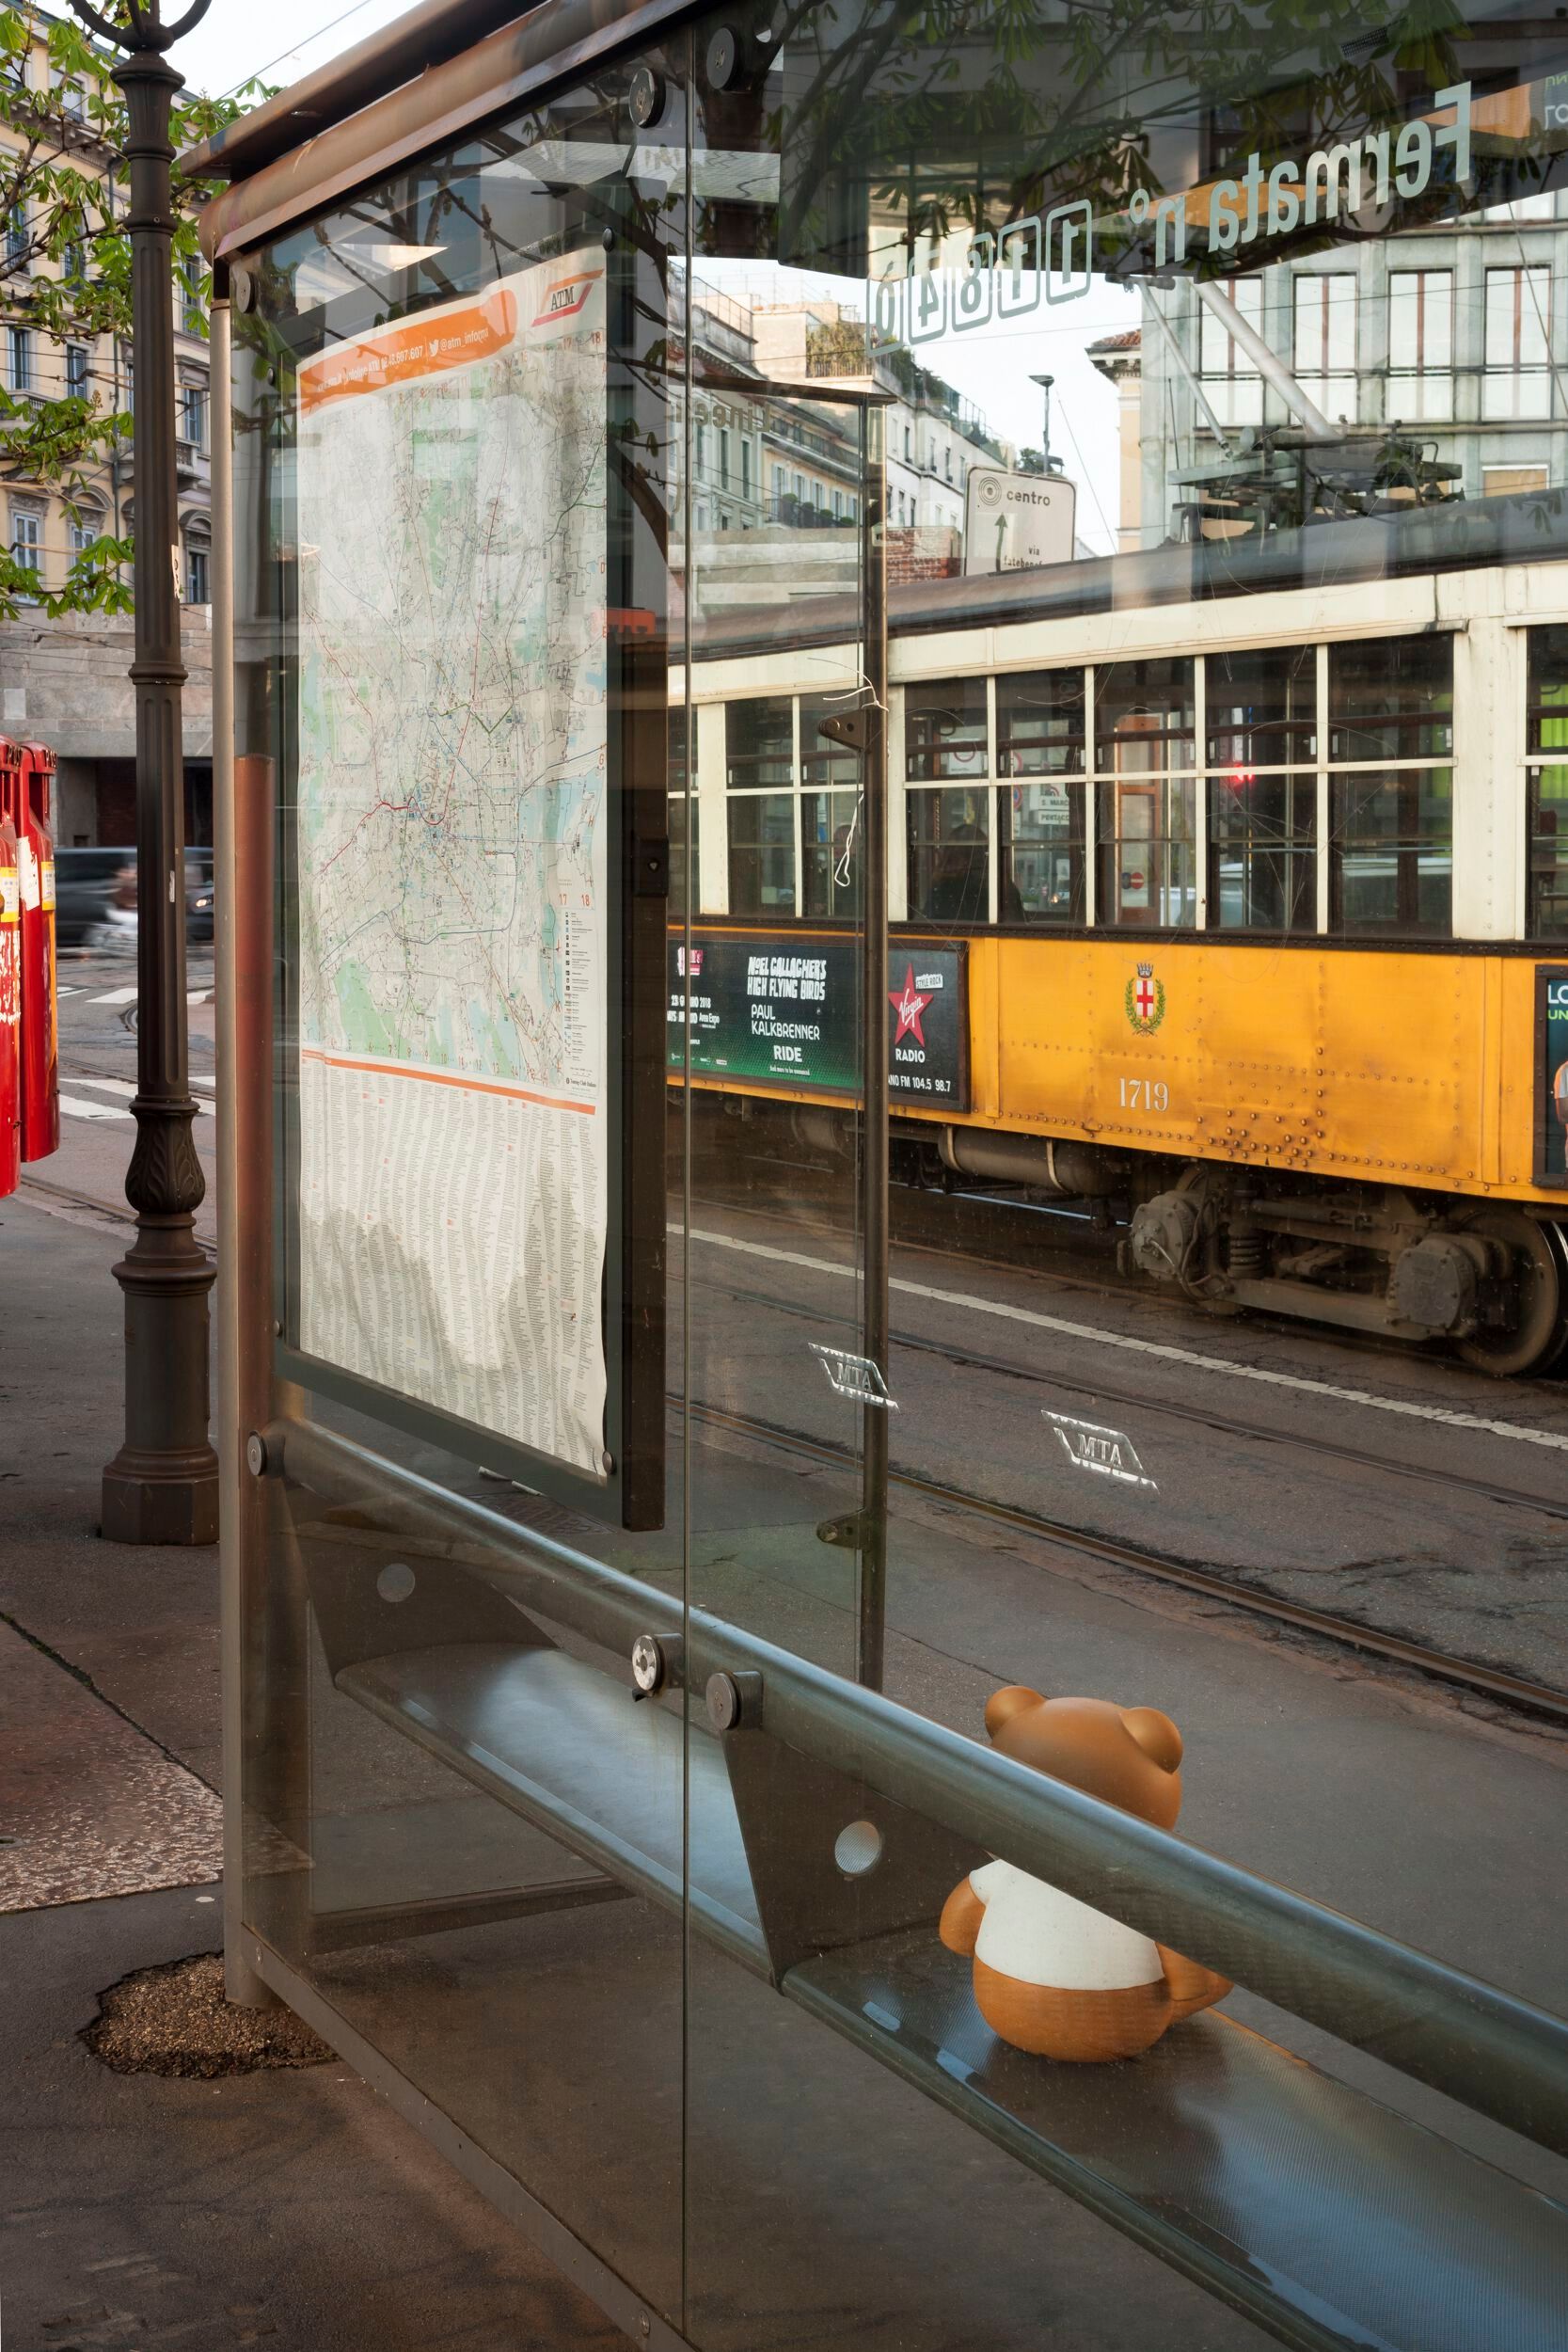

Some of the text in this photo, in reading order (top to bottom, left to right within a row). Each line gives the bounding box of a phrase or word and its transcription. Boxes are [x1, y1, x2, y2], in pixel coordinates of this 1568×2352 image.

[550, 285, 575, 312] ATM
[1006, 490, 1051, 507] centro
[1028, 545, 1039, 556] via
[581, 894, 591, 908] 18
[746, 976, 826, 1001] HIGH FLYING BIRDS
[751, 1004, 776, 1021] PAUL
[899, 988, 924, 1028] Virgin
[751, 1020, 821, 1041] KALKBRENNER
[773, 1044, 803, 1063] RIDE
[895, 1047, 926, 1064] RADIO
[900, 1076, 911, 1088] FM
[912, 1077, 932, 1091] 104.5
[934, 1079, 952, 1093] 98.7
[1119, 1077, 1168, 1113] 1719
